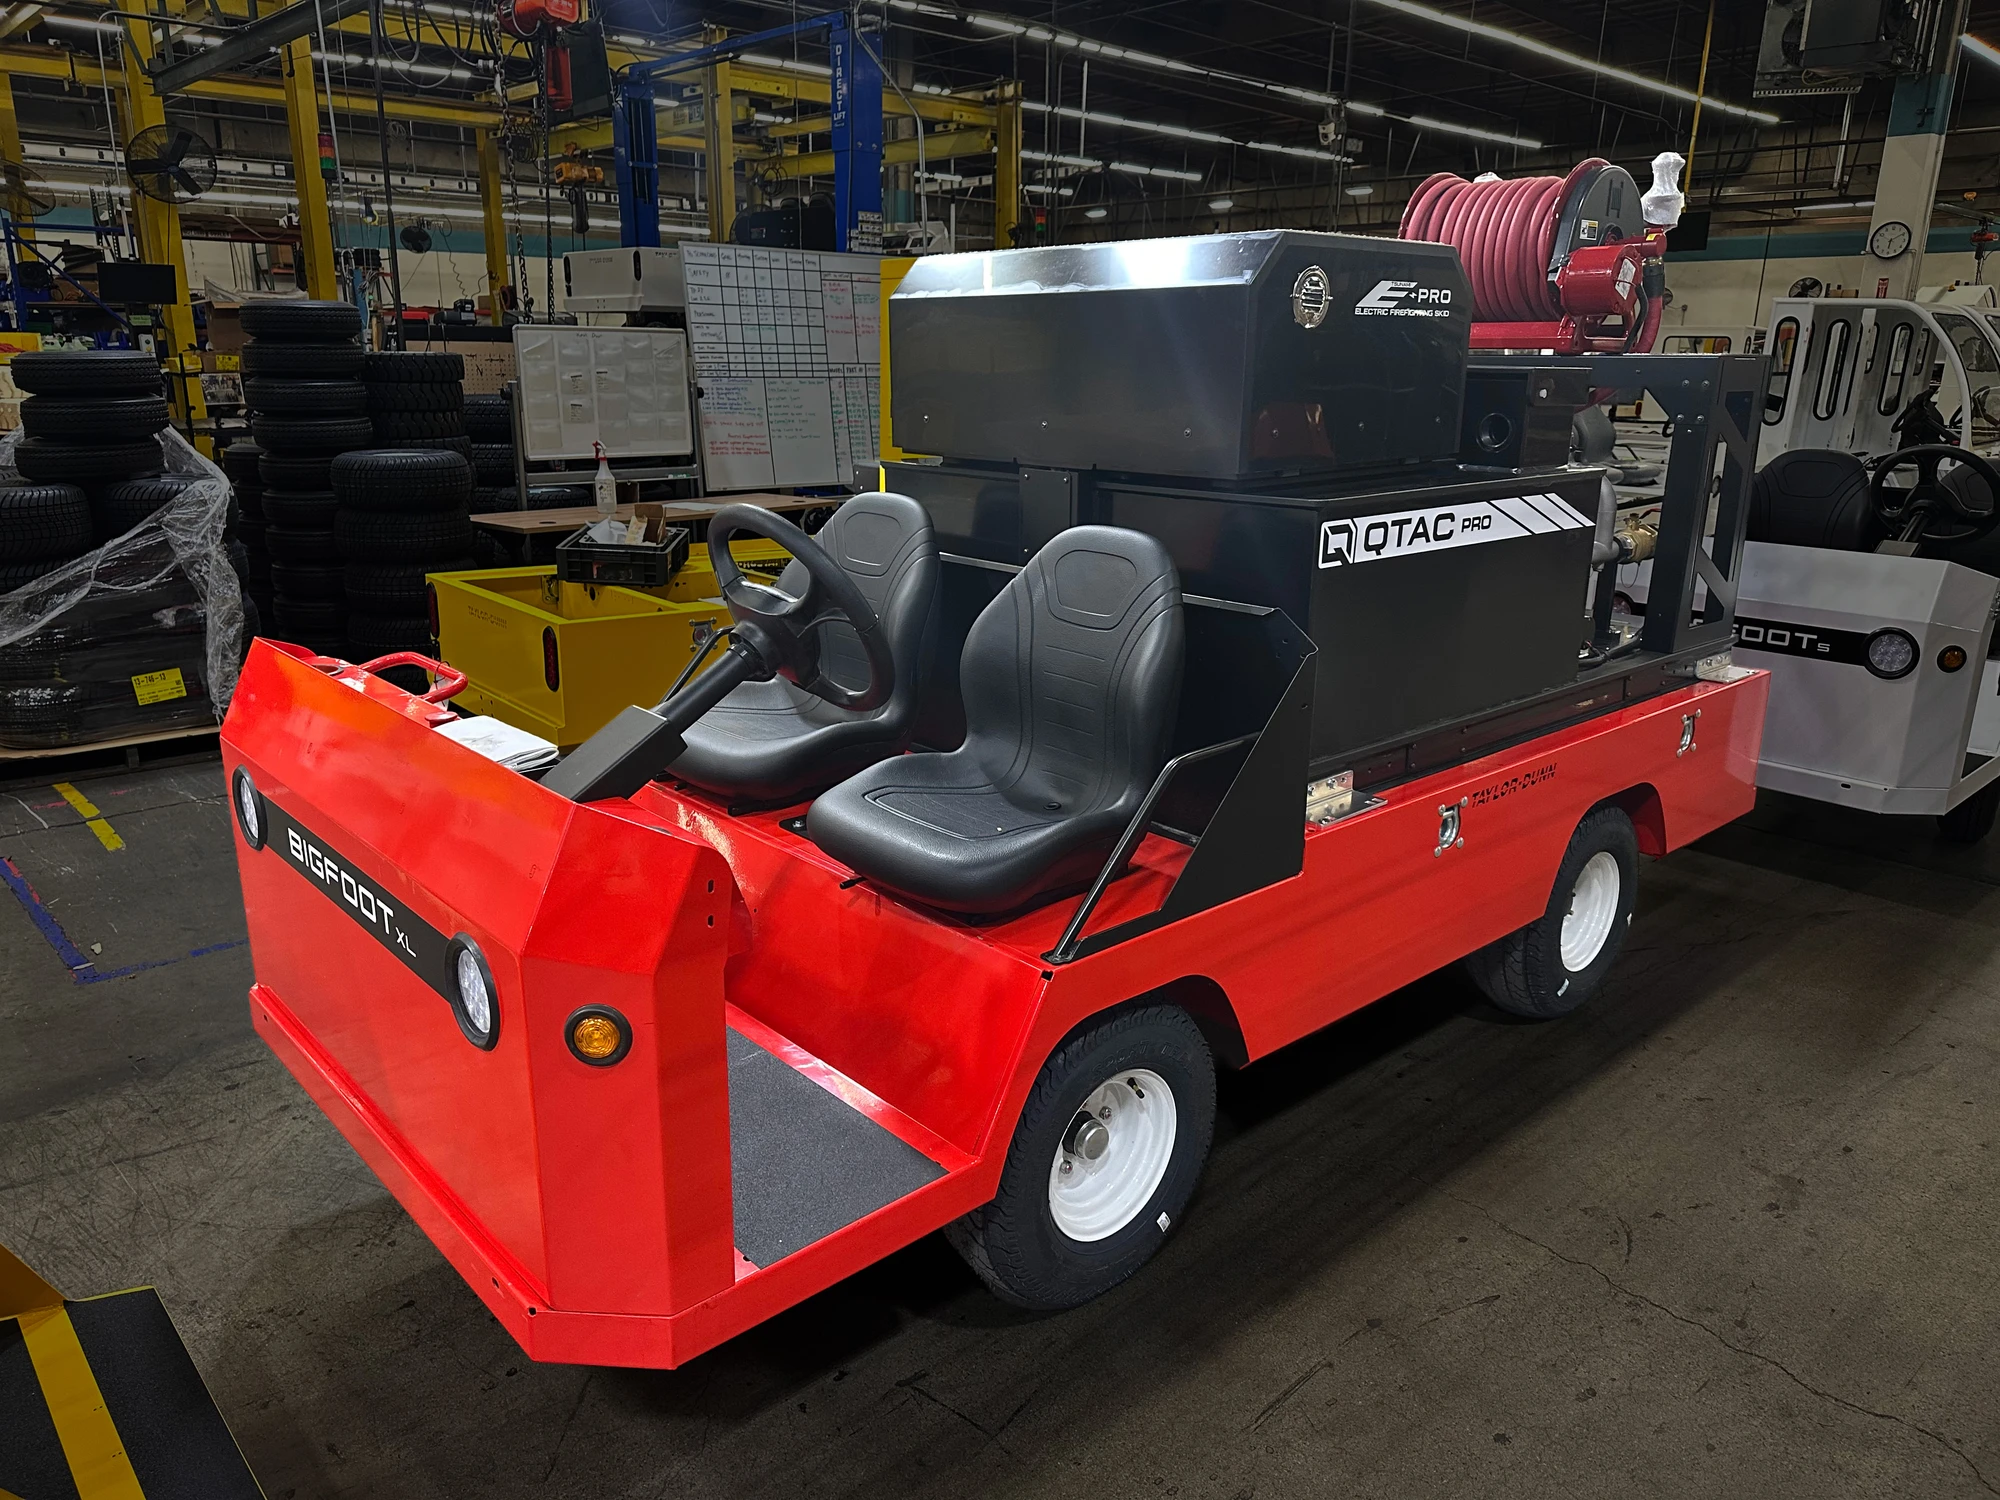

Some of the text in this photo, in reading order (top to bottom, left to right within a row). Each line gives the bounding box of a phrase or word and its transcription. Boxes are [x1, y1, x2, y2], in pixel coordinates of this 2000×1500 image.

[833, 111, 846, 121] LIFT
[1354, 307, 1389, 316] ELECTRIC
[1434, 309, 1450, 317] SKID
[1363, 512, 1455, 556] QTAC
[1461, 515, 1492, 533] PRO
[1472, 762, 1557, 808] TAYLOR-DUNN
[287, 827, 417, 958] BIGFOOT XL
